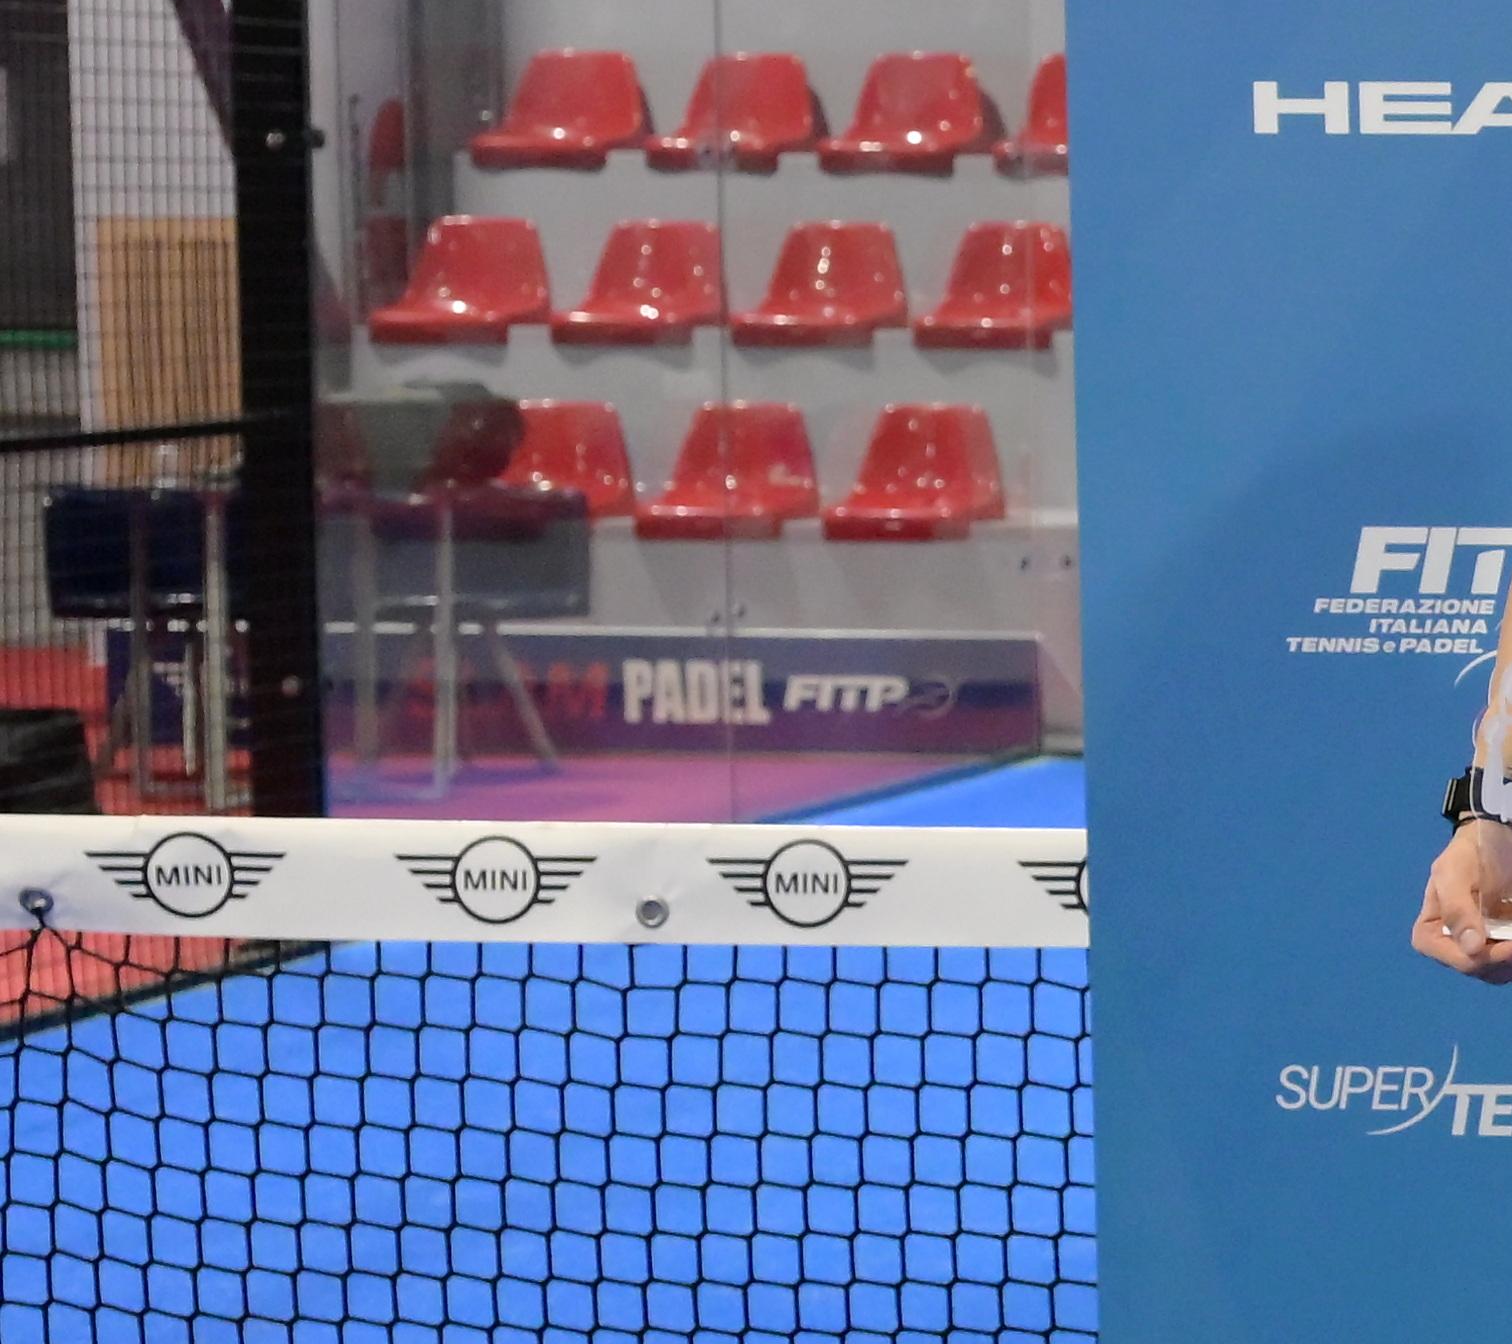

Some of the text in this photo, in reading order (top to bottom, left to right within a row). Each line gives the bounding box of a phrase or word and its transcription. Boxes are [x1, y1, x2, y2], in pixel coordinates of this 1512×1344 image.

[1313, 598, 1497, 615] FEDERAZIONE
[1369, 619, 1489, 635] ITALIANA
[1286, 637, 1485, 654] TENNIS e PADEL
[622, 657, 772, 725] PADEL
[782, 673, 910, 713] FITP
[155, 864, 223, 888] MINI
[463, 868, 529, 893] MINI
[774, 872, 838, 895] MINI
